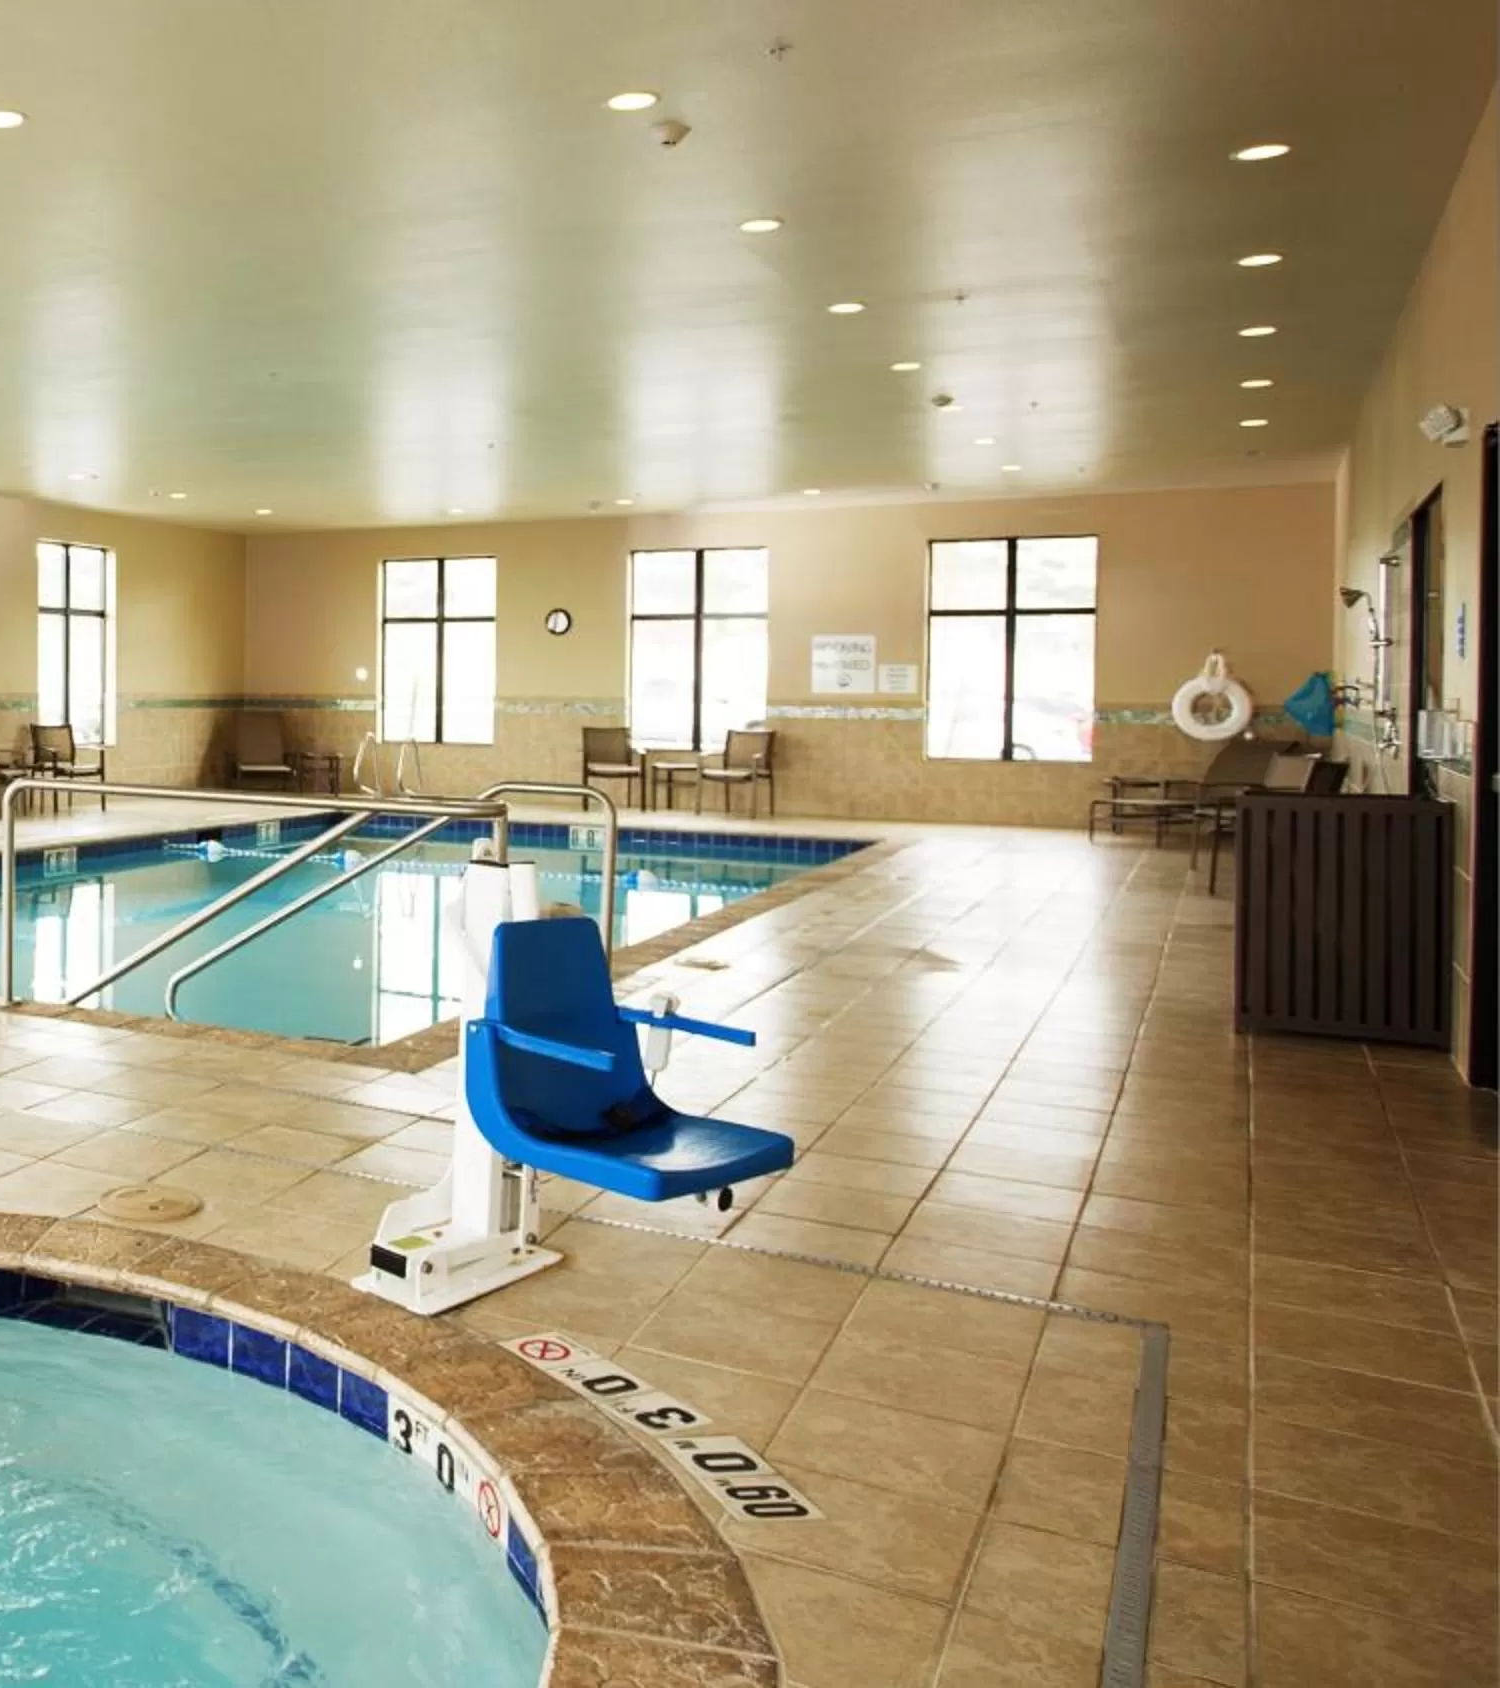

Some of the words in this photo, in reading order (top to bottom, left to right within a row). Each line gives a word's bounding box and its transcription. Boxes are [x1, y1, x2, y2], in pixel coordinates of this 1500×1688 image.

[581, 1374, 640, 1396] 0
[634, 1406, 697, 1431] 3
[394, 1409, 413, 1455] 3
[436, 1441, 455, 1494] 0
